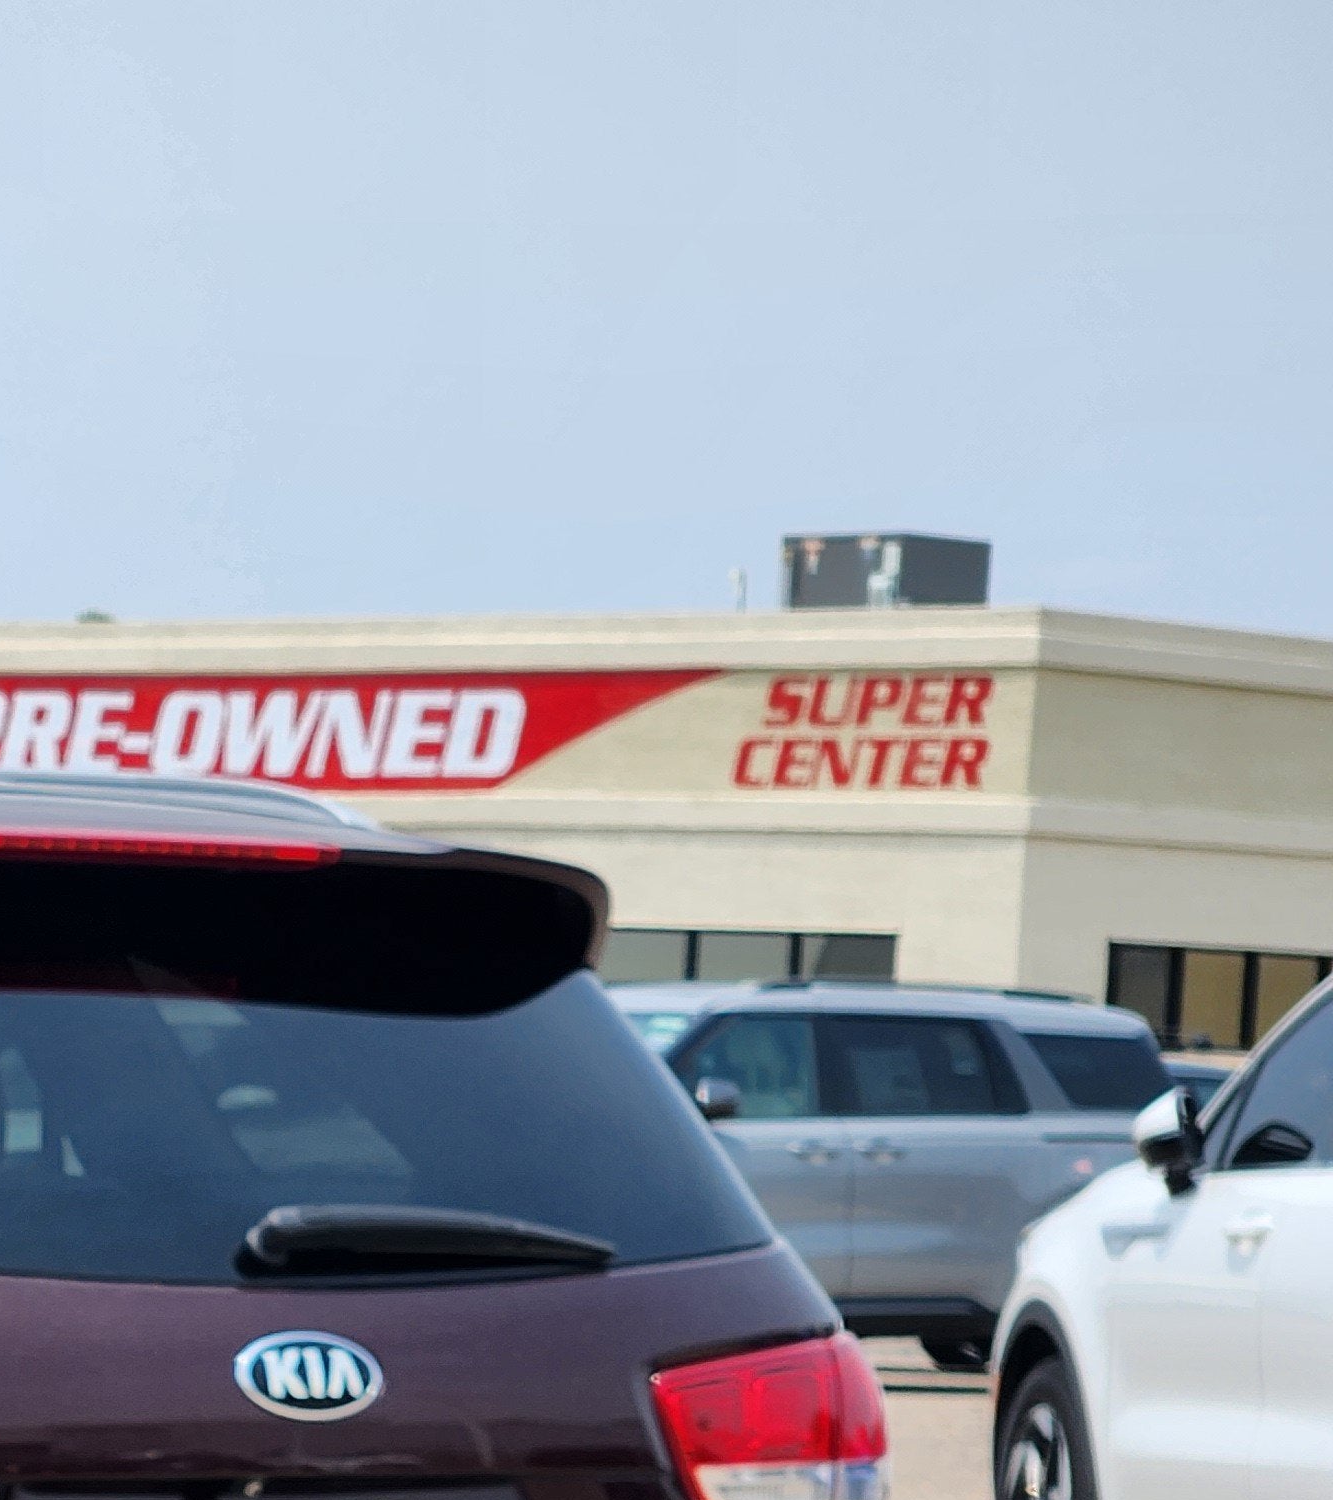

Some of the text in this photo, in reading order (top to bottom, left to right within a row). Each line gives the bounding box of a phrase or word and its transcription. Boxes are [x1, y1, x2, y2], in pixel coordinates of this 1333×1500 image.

[763, 675, 994, 728] SUPER
[732, 736, 991, 787] CENTER
[263, 1346, 365, 1400] KIA
